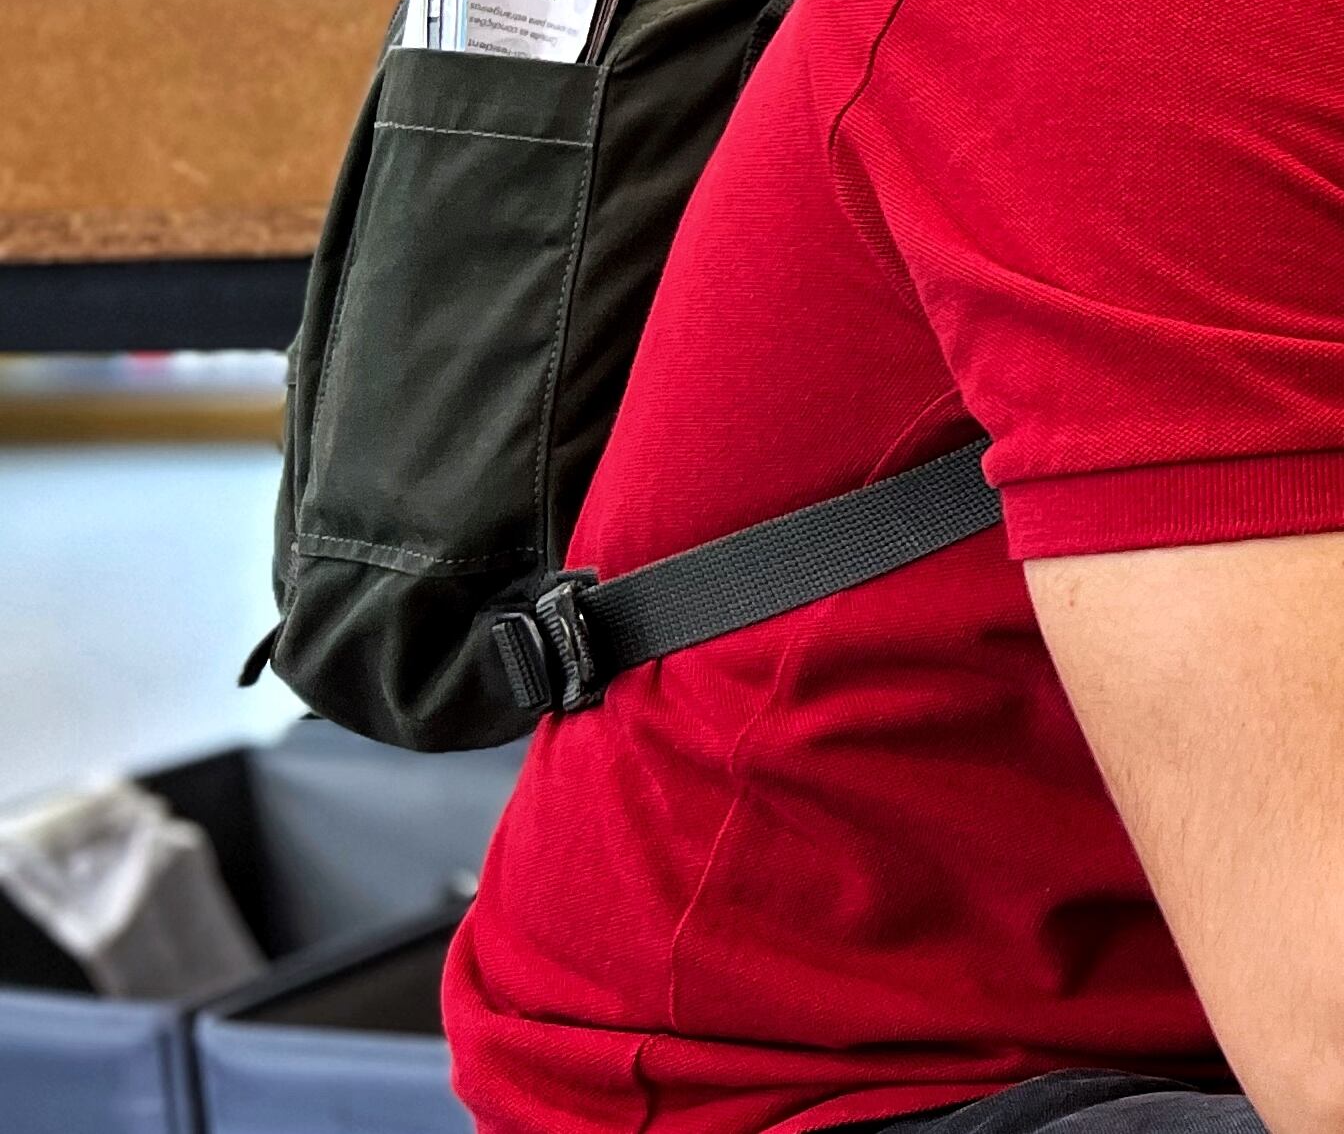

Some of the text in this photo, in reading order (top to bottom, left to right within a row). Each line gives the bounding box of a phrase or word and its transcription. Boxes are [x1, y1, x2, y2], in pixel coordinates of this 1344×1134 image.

[470, 2, 546, 27] para estrangeiros
[469, 17, 518, 35] condições
